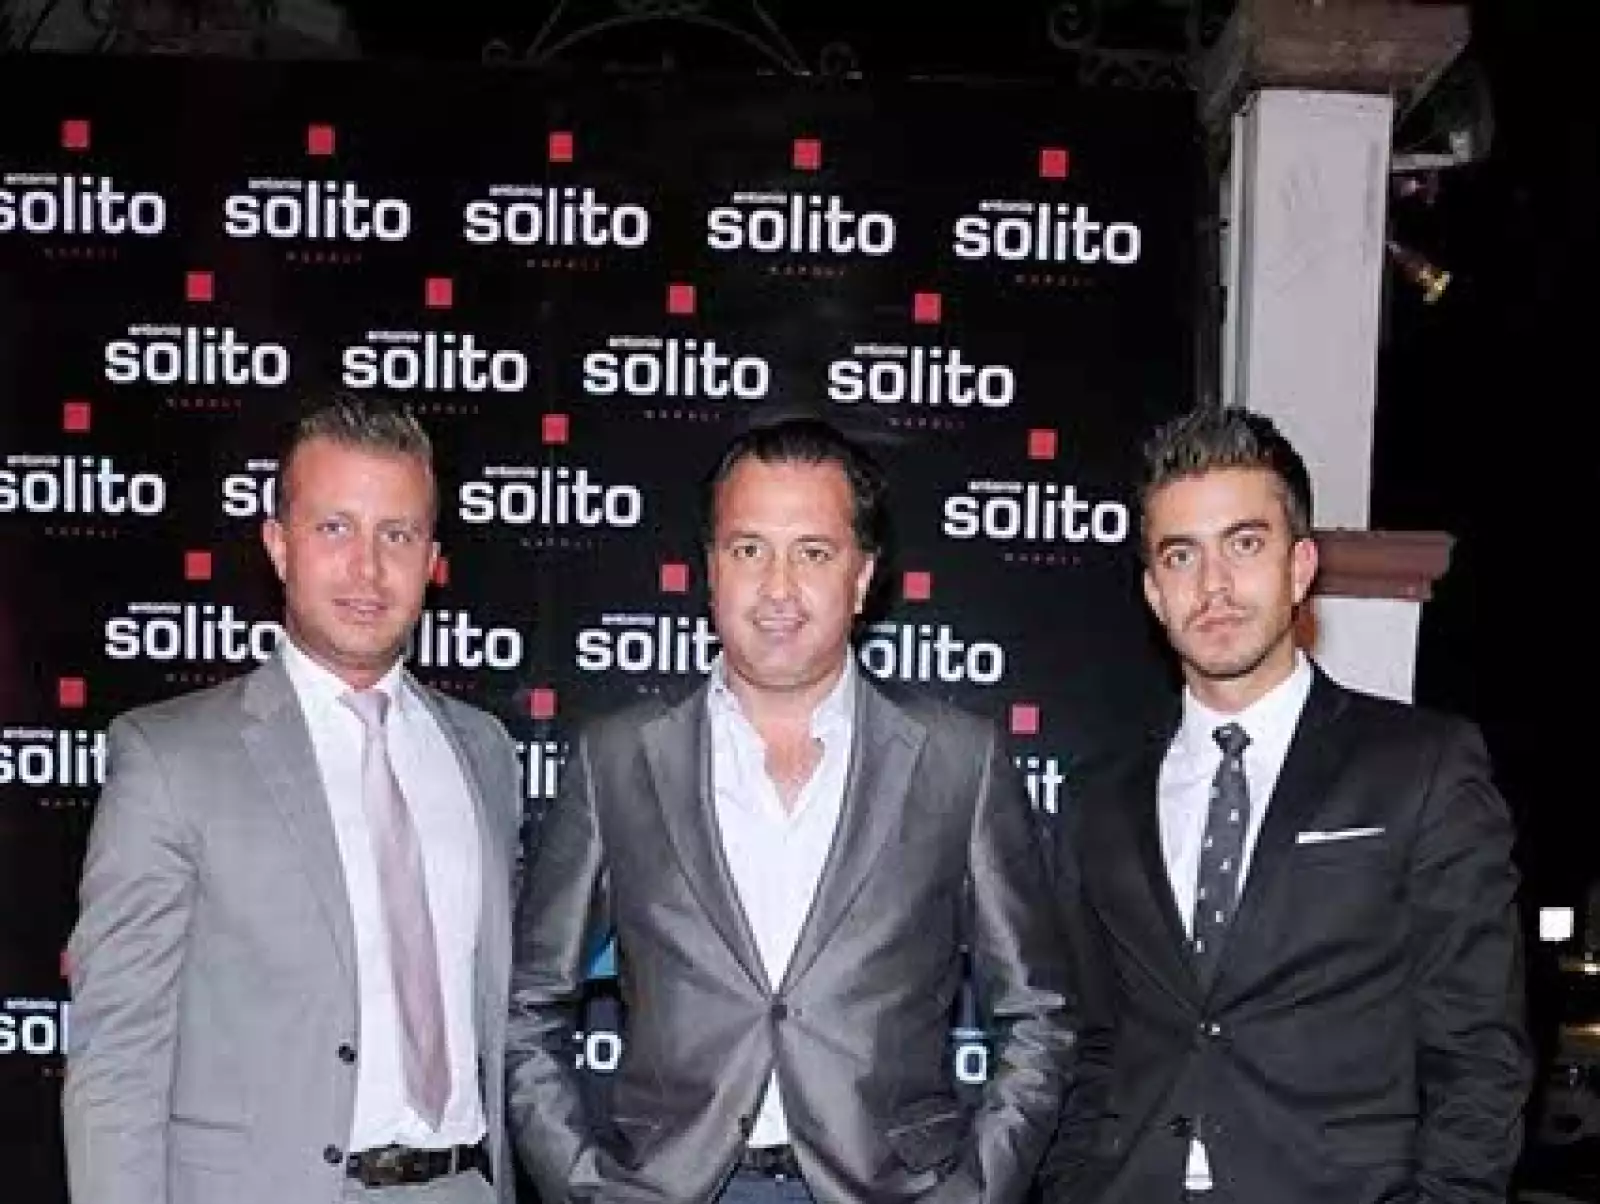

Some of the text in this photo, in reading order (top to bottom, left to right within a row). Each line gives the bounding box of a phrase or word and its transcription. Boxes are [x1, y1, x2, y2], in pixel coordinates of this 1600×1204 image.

[224, 180, 411, 241] solito
[464, 186, 648, 246] solito
[708, 194, 896, 254] solito
[953, 202, 1141, 264] solito
[105, 326, 289, 386] solito
[342, 332, 528, 392] solito
[584, 339, 768, 400] solito
[828, 346, 1014, 407] solito
[459, 467, 641, 528] solito
[944, 482, 1129, 543] solito
[105, 604, 284, 662] solito
[420, 610, 522, 671] lito
[576, 614, 717, 675] solit
[859, 625, 1005, 685] olito
[0, 730, 107, 787] olit
